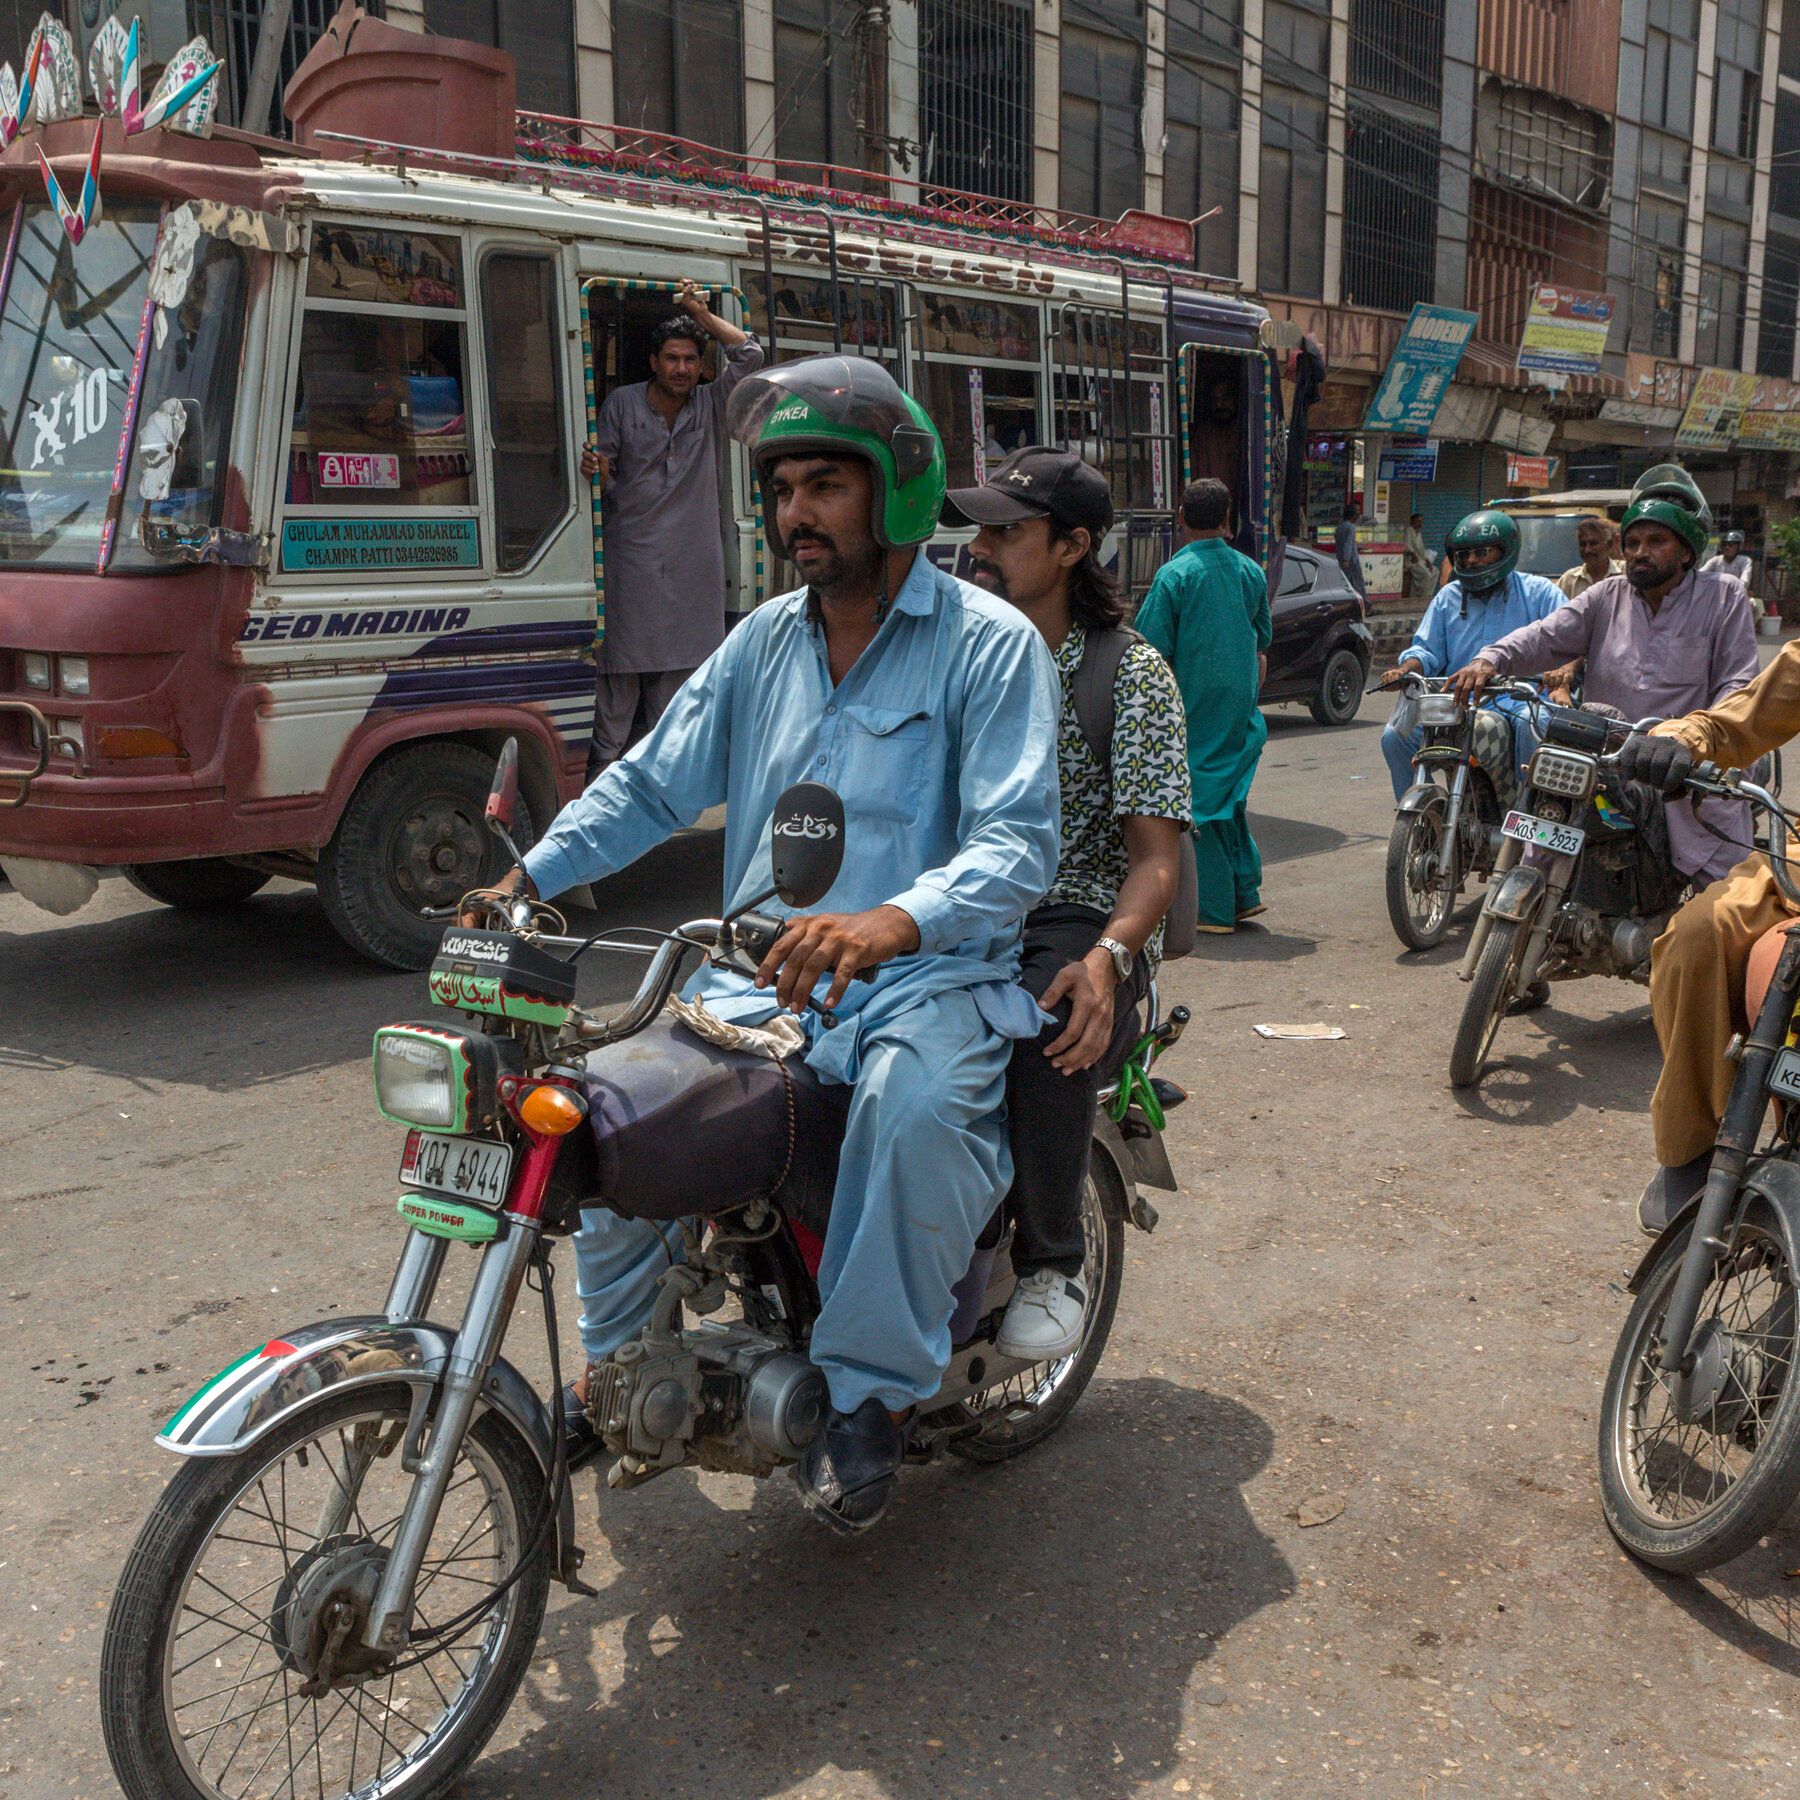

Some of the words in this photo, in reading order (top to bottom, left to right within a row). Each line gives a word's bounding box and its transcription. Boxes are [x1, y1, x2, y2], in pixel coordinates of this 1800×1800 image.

[1408, 315, 1471, 345] MODERN
[1405, 339, 1434, 351] VARIETY
[1436, 343, 1461, 355] HOUSE
[1699, 370, 1732, 394] ARYAN
[770, 406, 808, 424] BYKEA
[288, 525, 340, 542] GHULAM
[344, 524, 415, 541] MUHAMMAD
[418, 523, 471, 540] SHAKEEL
[361, 547, 393, 564] PATTI
[241, 614, 323, 642] GEO
[322, 607, 471, 638] MADINA
[1548, 832, 1579, 852] 2923
[456, 1146, 503, 1199] 6944
[402, 1203, 427, 1219] SUPER
[428, 1210, 465, 1227] POWER
